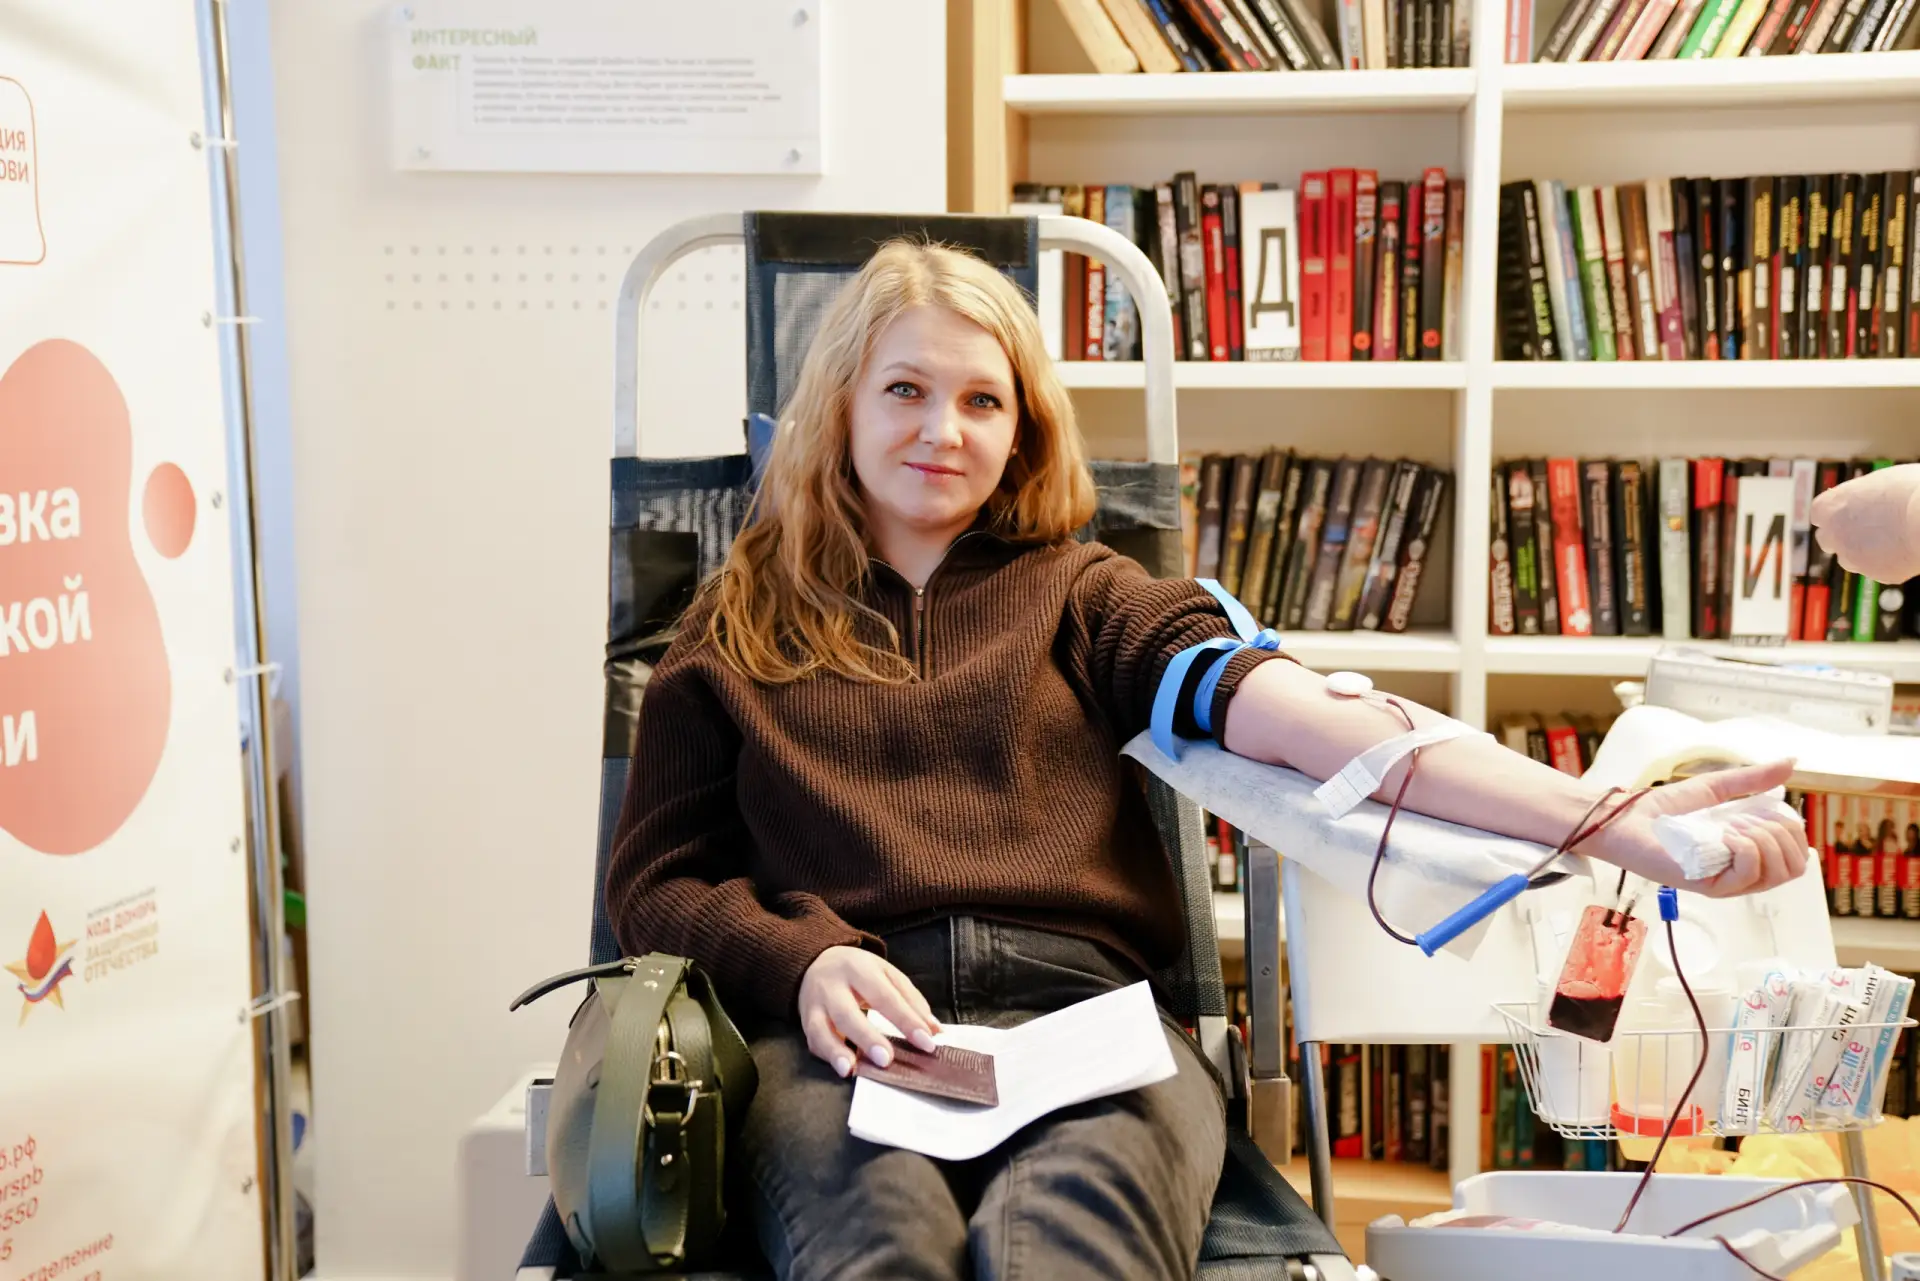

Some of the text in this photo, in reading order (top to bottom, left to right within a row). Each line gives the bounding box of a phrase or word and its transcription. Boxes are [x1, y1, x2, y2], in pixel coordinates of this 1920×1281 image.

[411, 26, 538, 47] ИНТЕРЕСНЫЙ
[412, 54, 461, 71] ФАКТ
[1250, 228, 1294, 329] Д
[0, 487, 80, 545] вка
[1742, 514, 1786, 599] И
[0, 573, 92, 657] кой
[0, 710, 38, 767] и
[1736, 1087, 1751, 1125] БИНТ
[0, 1165, 43, 1202] rspb
